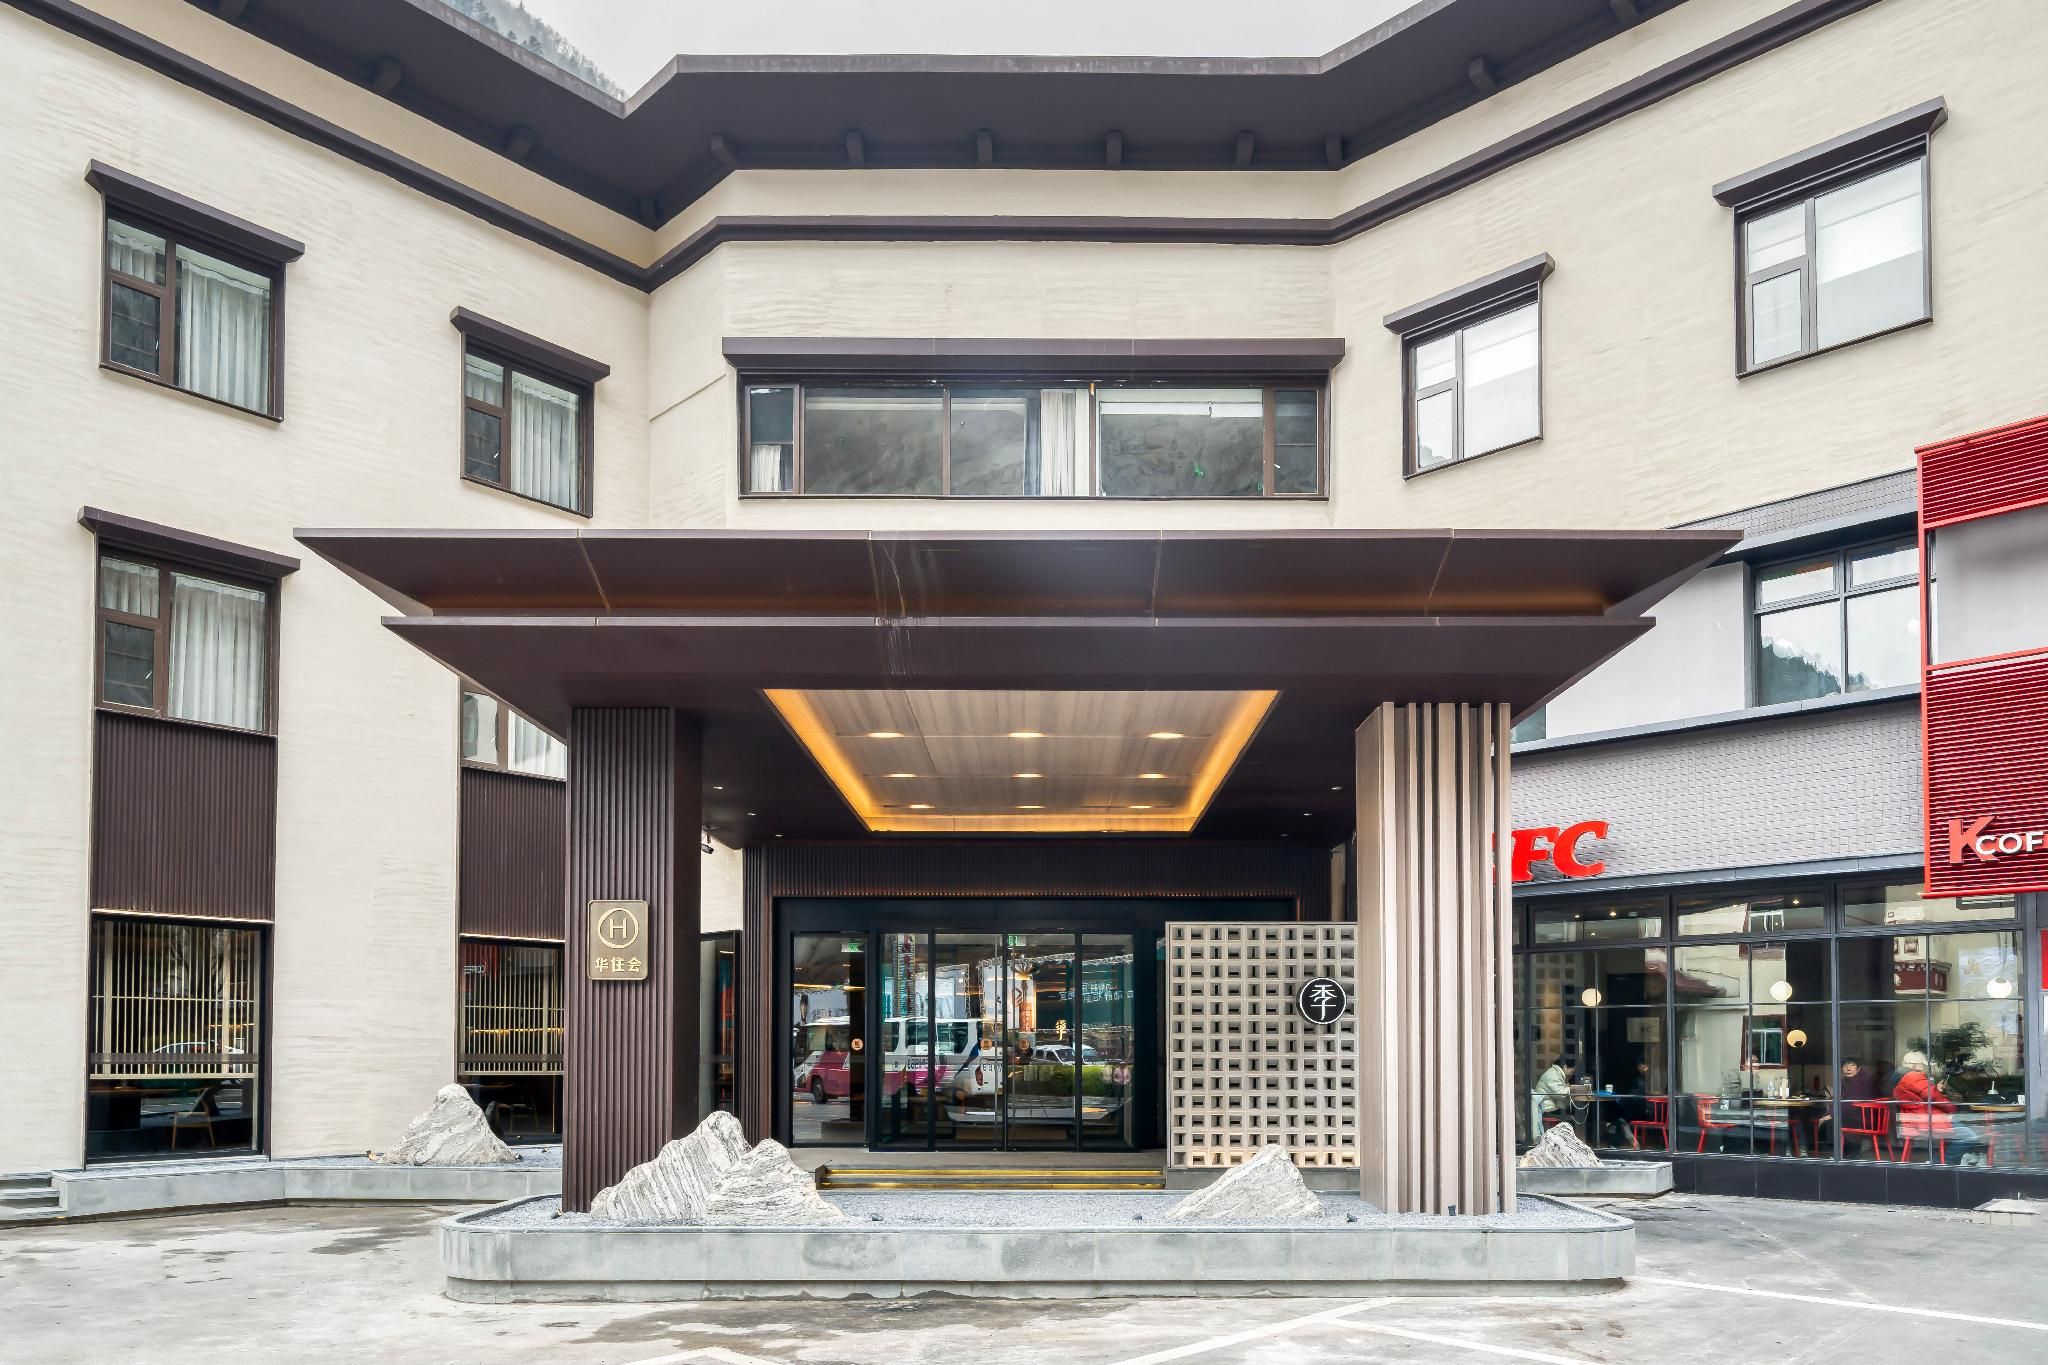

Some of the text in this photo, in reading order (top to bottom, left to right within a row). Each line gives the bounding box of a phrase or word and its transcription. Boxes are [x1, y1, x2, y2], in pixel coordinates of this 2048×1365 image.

[1492, 819, 1610, 882] FC
[609, 918, 627, 939] H
[595, 956, 642, 973] 华住会
[1309, 984, 1337, 1021] 季
